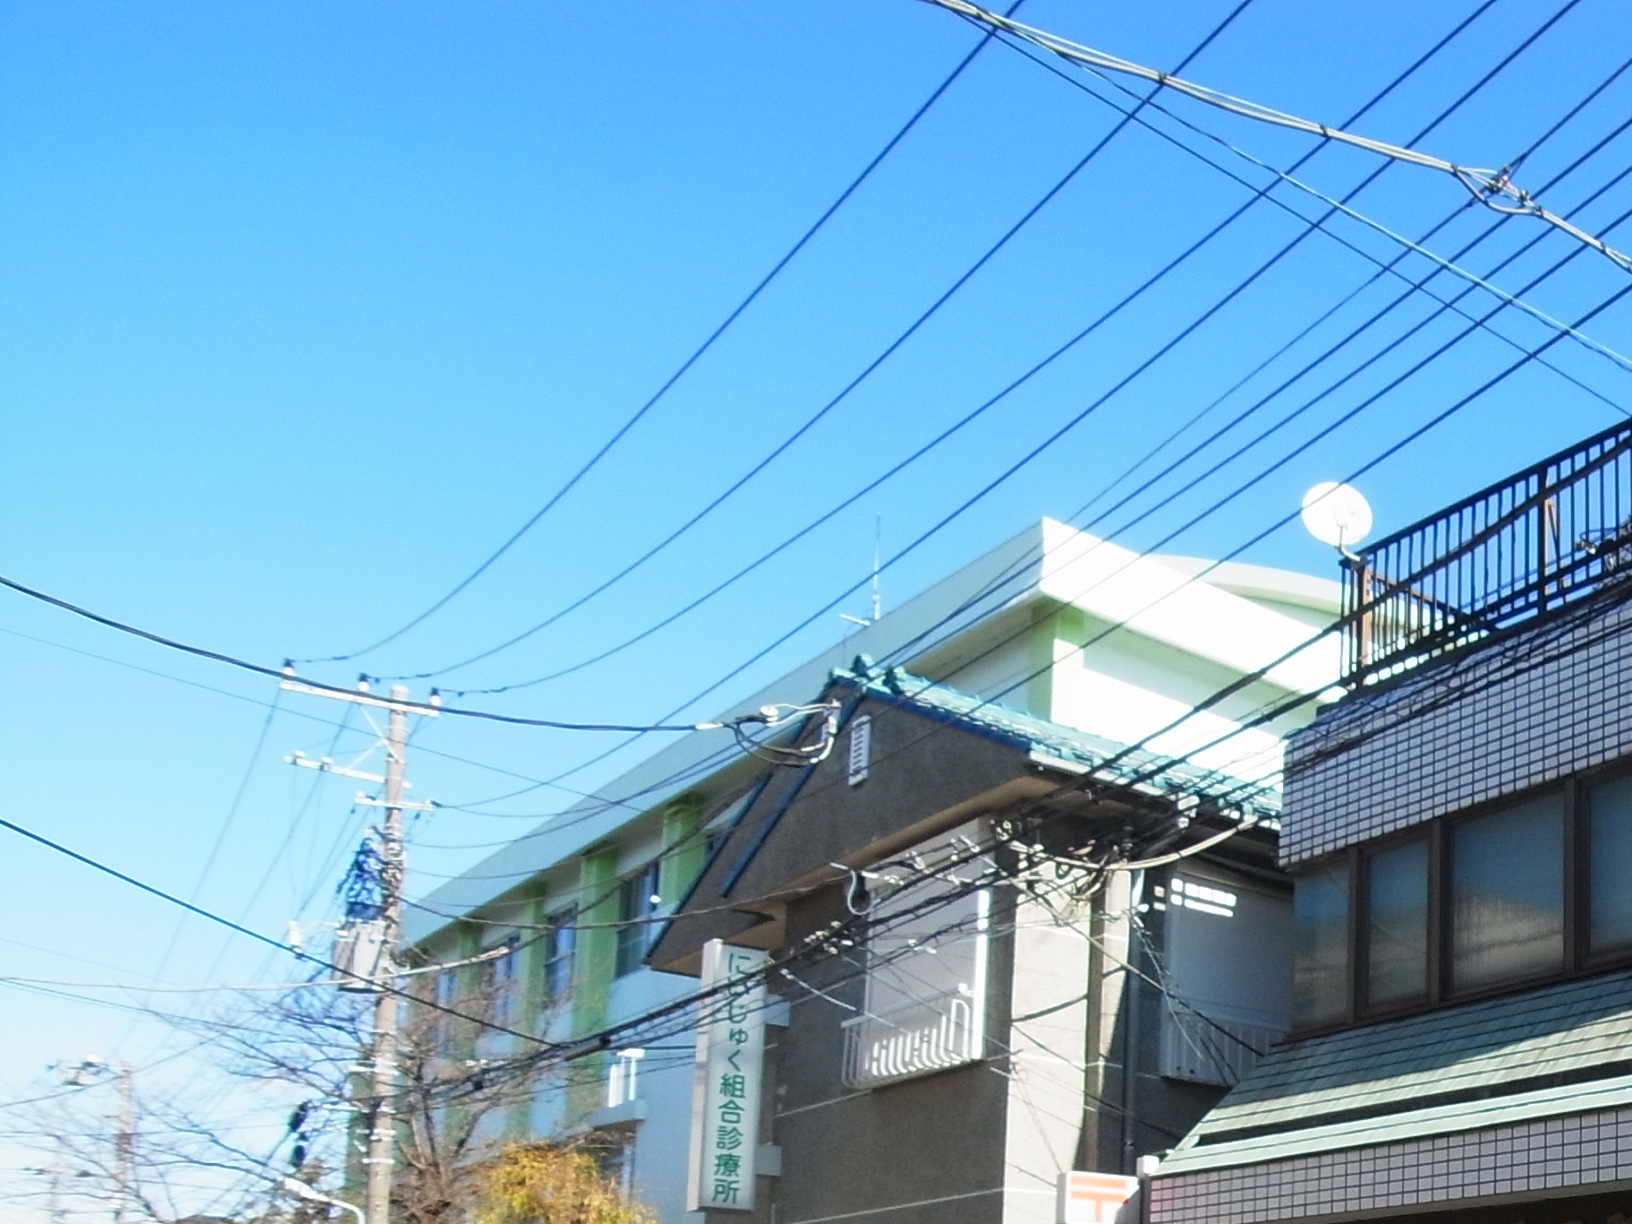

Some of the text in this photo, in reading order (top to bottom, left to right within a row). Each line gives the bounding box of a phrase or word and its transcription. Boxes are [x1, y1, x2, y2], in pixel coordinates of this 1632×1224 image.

[711, 952, 751, 1205] にいじゅく組合診療所
